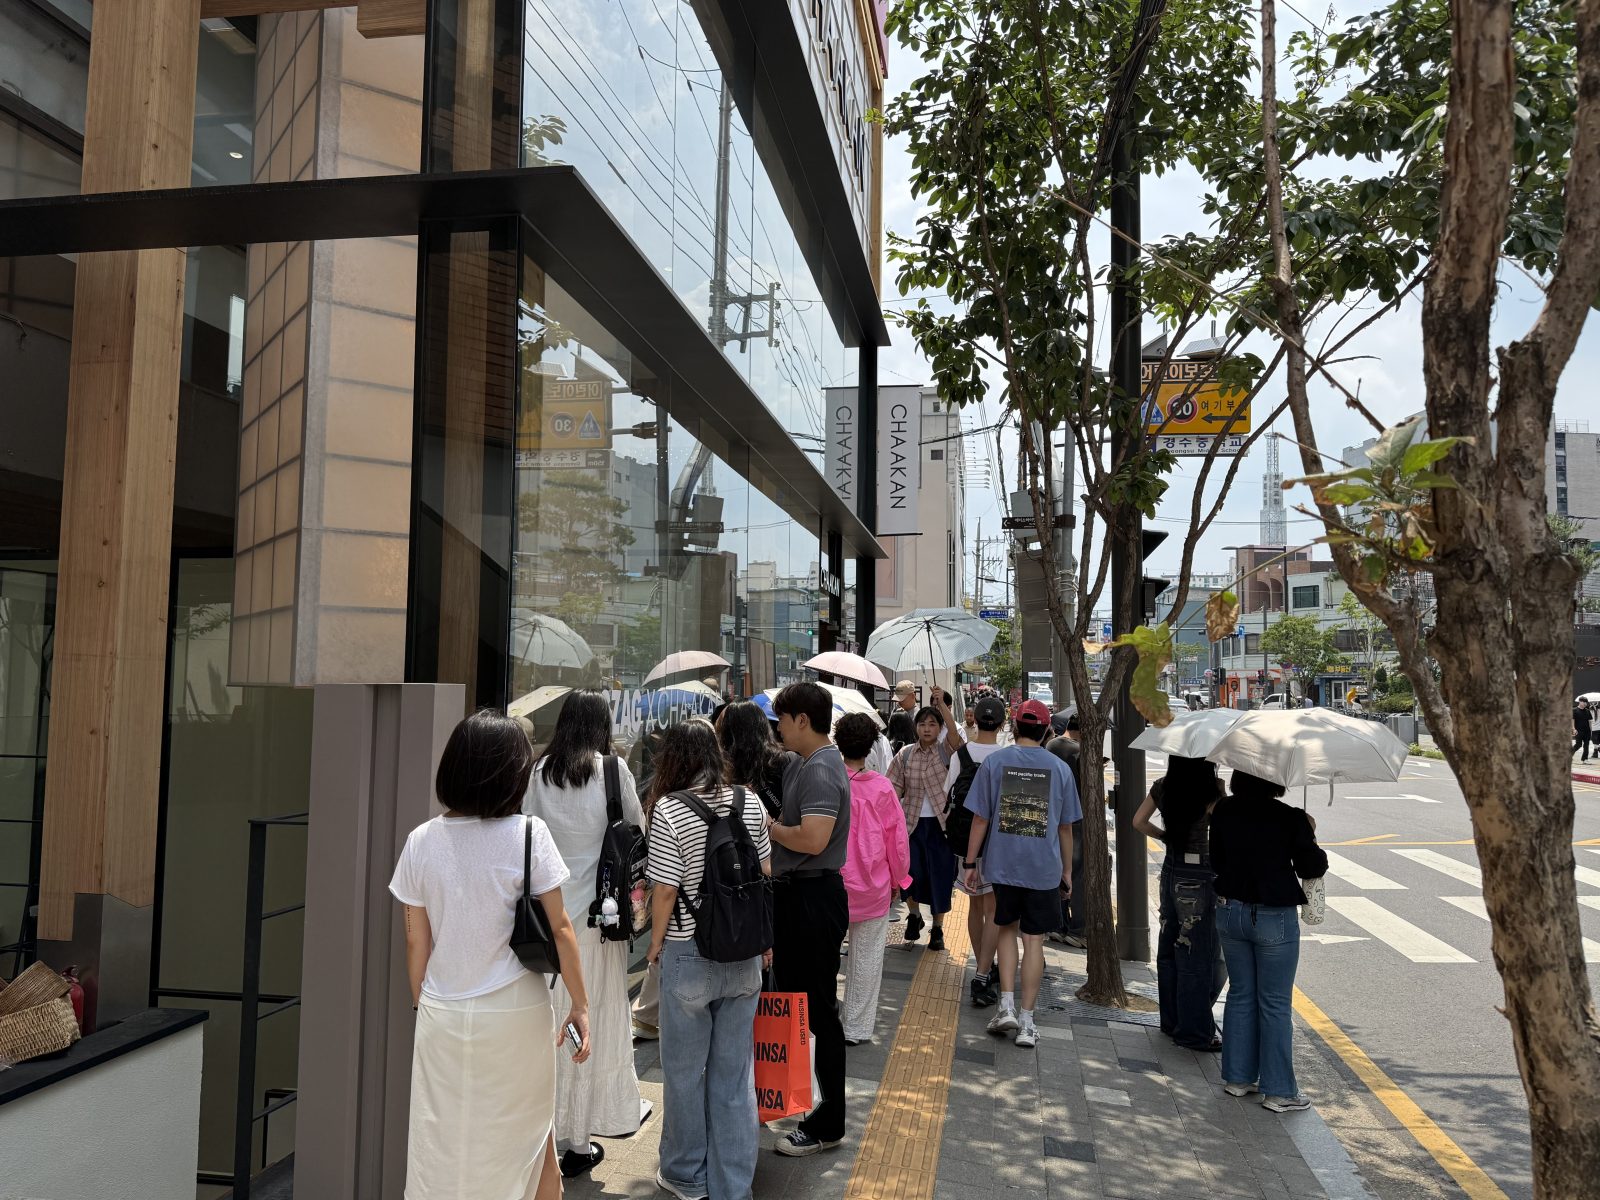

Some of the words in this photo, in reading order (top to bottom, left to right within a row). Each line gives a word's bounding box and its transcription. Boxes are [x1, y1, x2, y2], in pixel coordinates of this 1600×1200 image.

[1201, 400, 1247, 411] 여기부
[890, 404, 908, 509] CHAAKAN
[645, 689, 656, 732] X
[755, 997, 790, 1018] INSA
[754, 1041, 787, 1064] INSA
